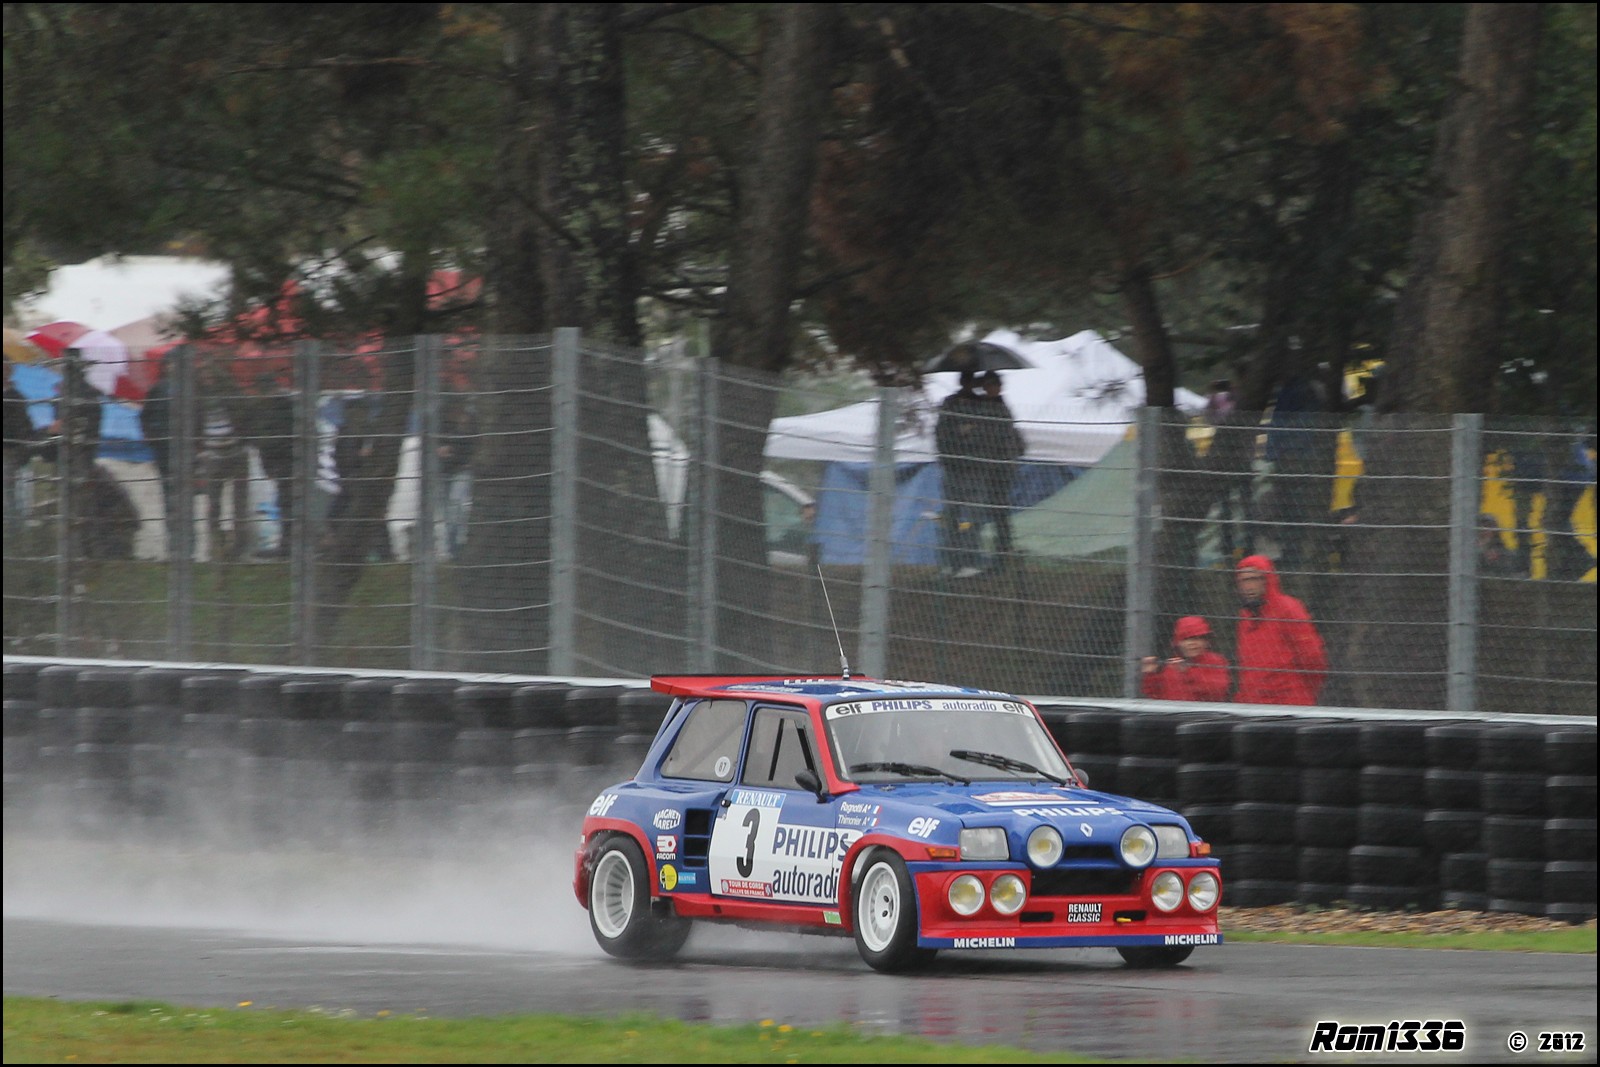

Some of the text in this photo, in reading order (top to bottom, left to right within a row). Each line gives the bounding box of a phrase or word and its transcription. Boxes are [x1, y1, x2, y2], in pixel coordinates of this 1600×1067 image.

[836, 700, 1026, 715] elf PHILIPS autoradio elf
[589, 794, 618, 816] elf
[736, 791, 781, 808] RENAULT
[653, 808, 681, 821] MAGNETI
[1012, 807, 1123, 817] PHILIPS
[653, 818, 681, 830] MARELLI
[907, 817, 940, 838] elf
[736, 808, 760, 878] 3
[772, 826, 850, 861] PHILIPS
[729, 880, 741, 888] TOUR
[1069, 903, 1102, 913] RENAULT
[1068, 913, 1101, 922] CLASSIC
[953, 937, 1016, 948] MICHELIN
[1164, 934, 1218, 945] MICHELIN
